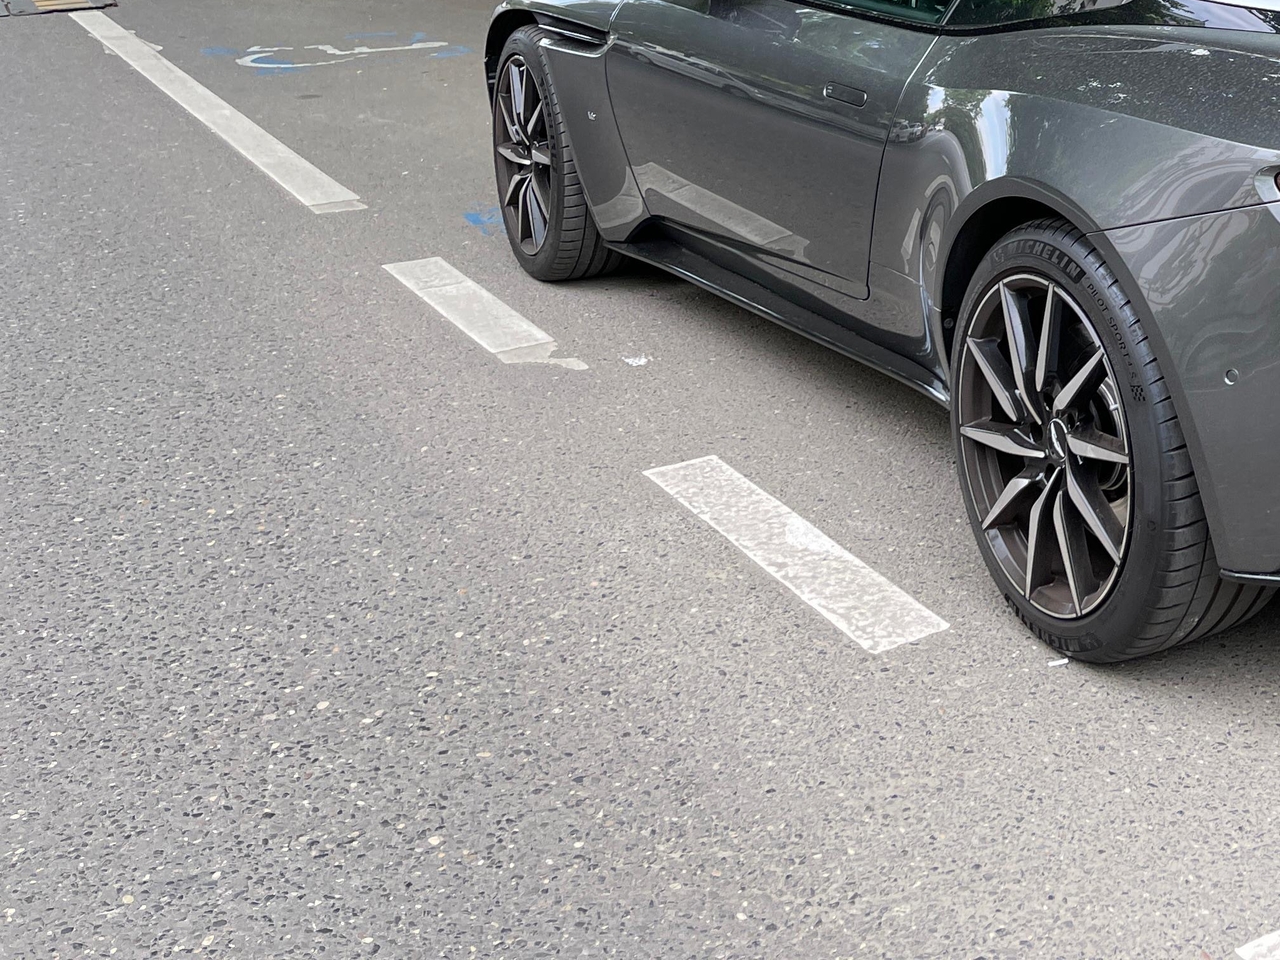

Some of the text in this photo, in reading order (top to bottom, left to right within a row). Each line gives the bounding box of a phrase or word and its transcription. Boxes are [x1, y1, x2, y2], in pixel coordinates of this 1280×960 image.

[1007, 240, 1082, 280] MICHELIN
[1086, 283, 1108, 313] PILOT
[1107, 316, 1129, 357] SPORT
